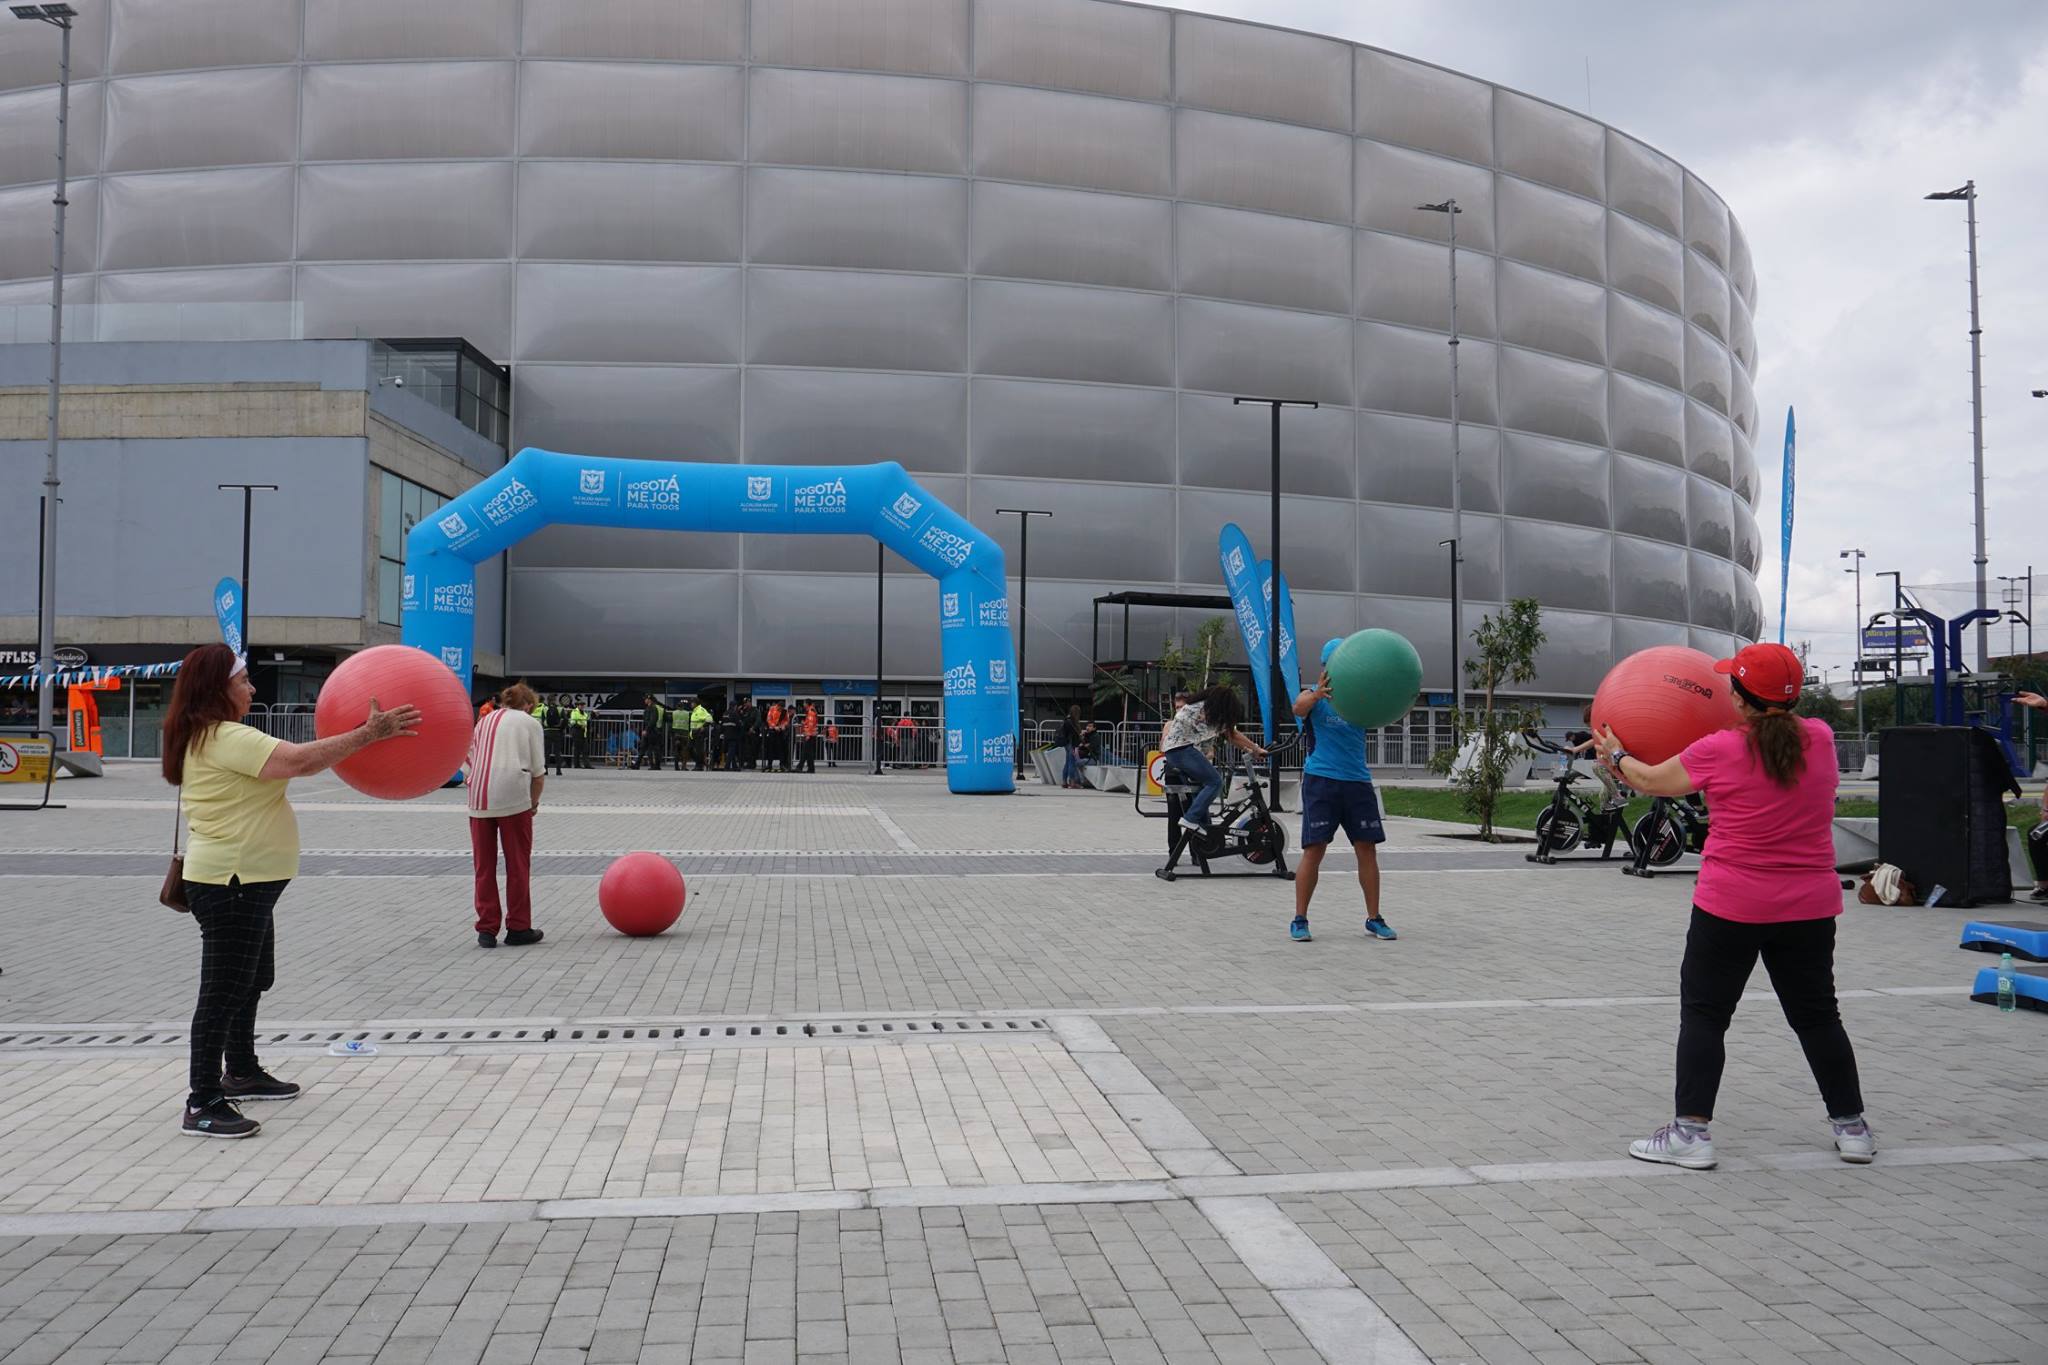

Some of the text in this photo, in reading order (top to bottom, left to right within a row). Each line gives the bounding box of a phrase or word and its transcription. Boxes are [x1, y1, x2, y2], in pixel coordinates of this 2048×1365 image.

[628, 474, 680, 491] BOGOTÁ
[794, 477, 846, 494] BOGOTÁ
[483, 477, 526, 512] BOGOTÁ
[627, 491, 680, 504] MEJOR
[794, 495, 846, 507] MEJOR
[487, 489, 533, 520] MEJOR
[514, 498, 538, 515] TODOS
[627, 502, 680, 511] PARA TODOS
[923, 531, 966, 564] MEJOR
[930, 526, 975, 556] BOGOTÁ
[937, 551, 960, 568] TODOS
[434, 594, 473, 607] MEJOR
[980, 609, 1008, 620] MEJO
[983, 746, 1013, 757] MEJO
